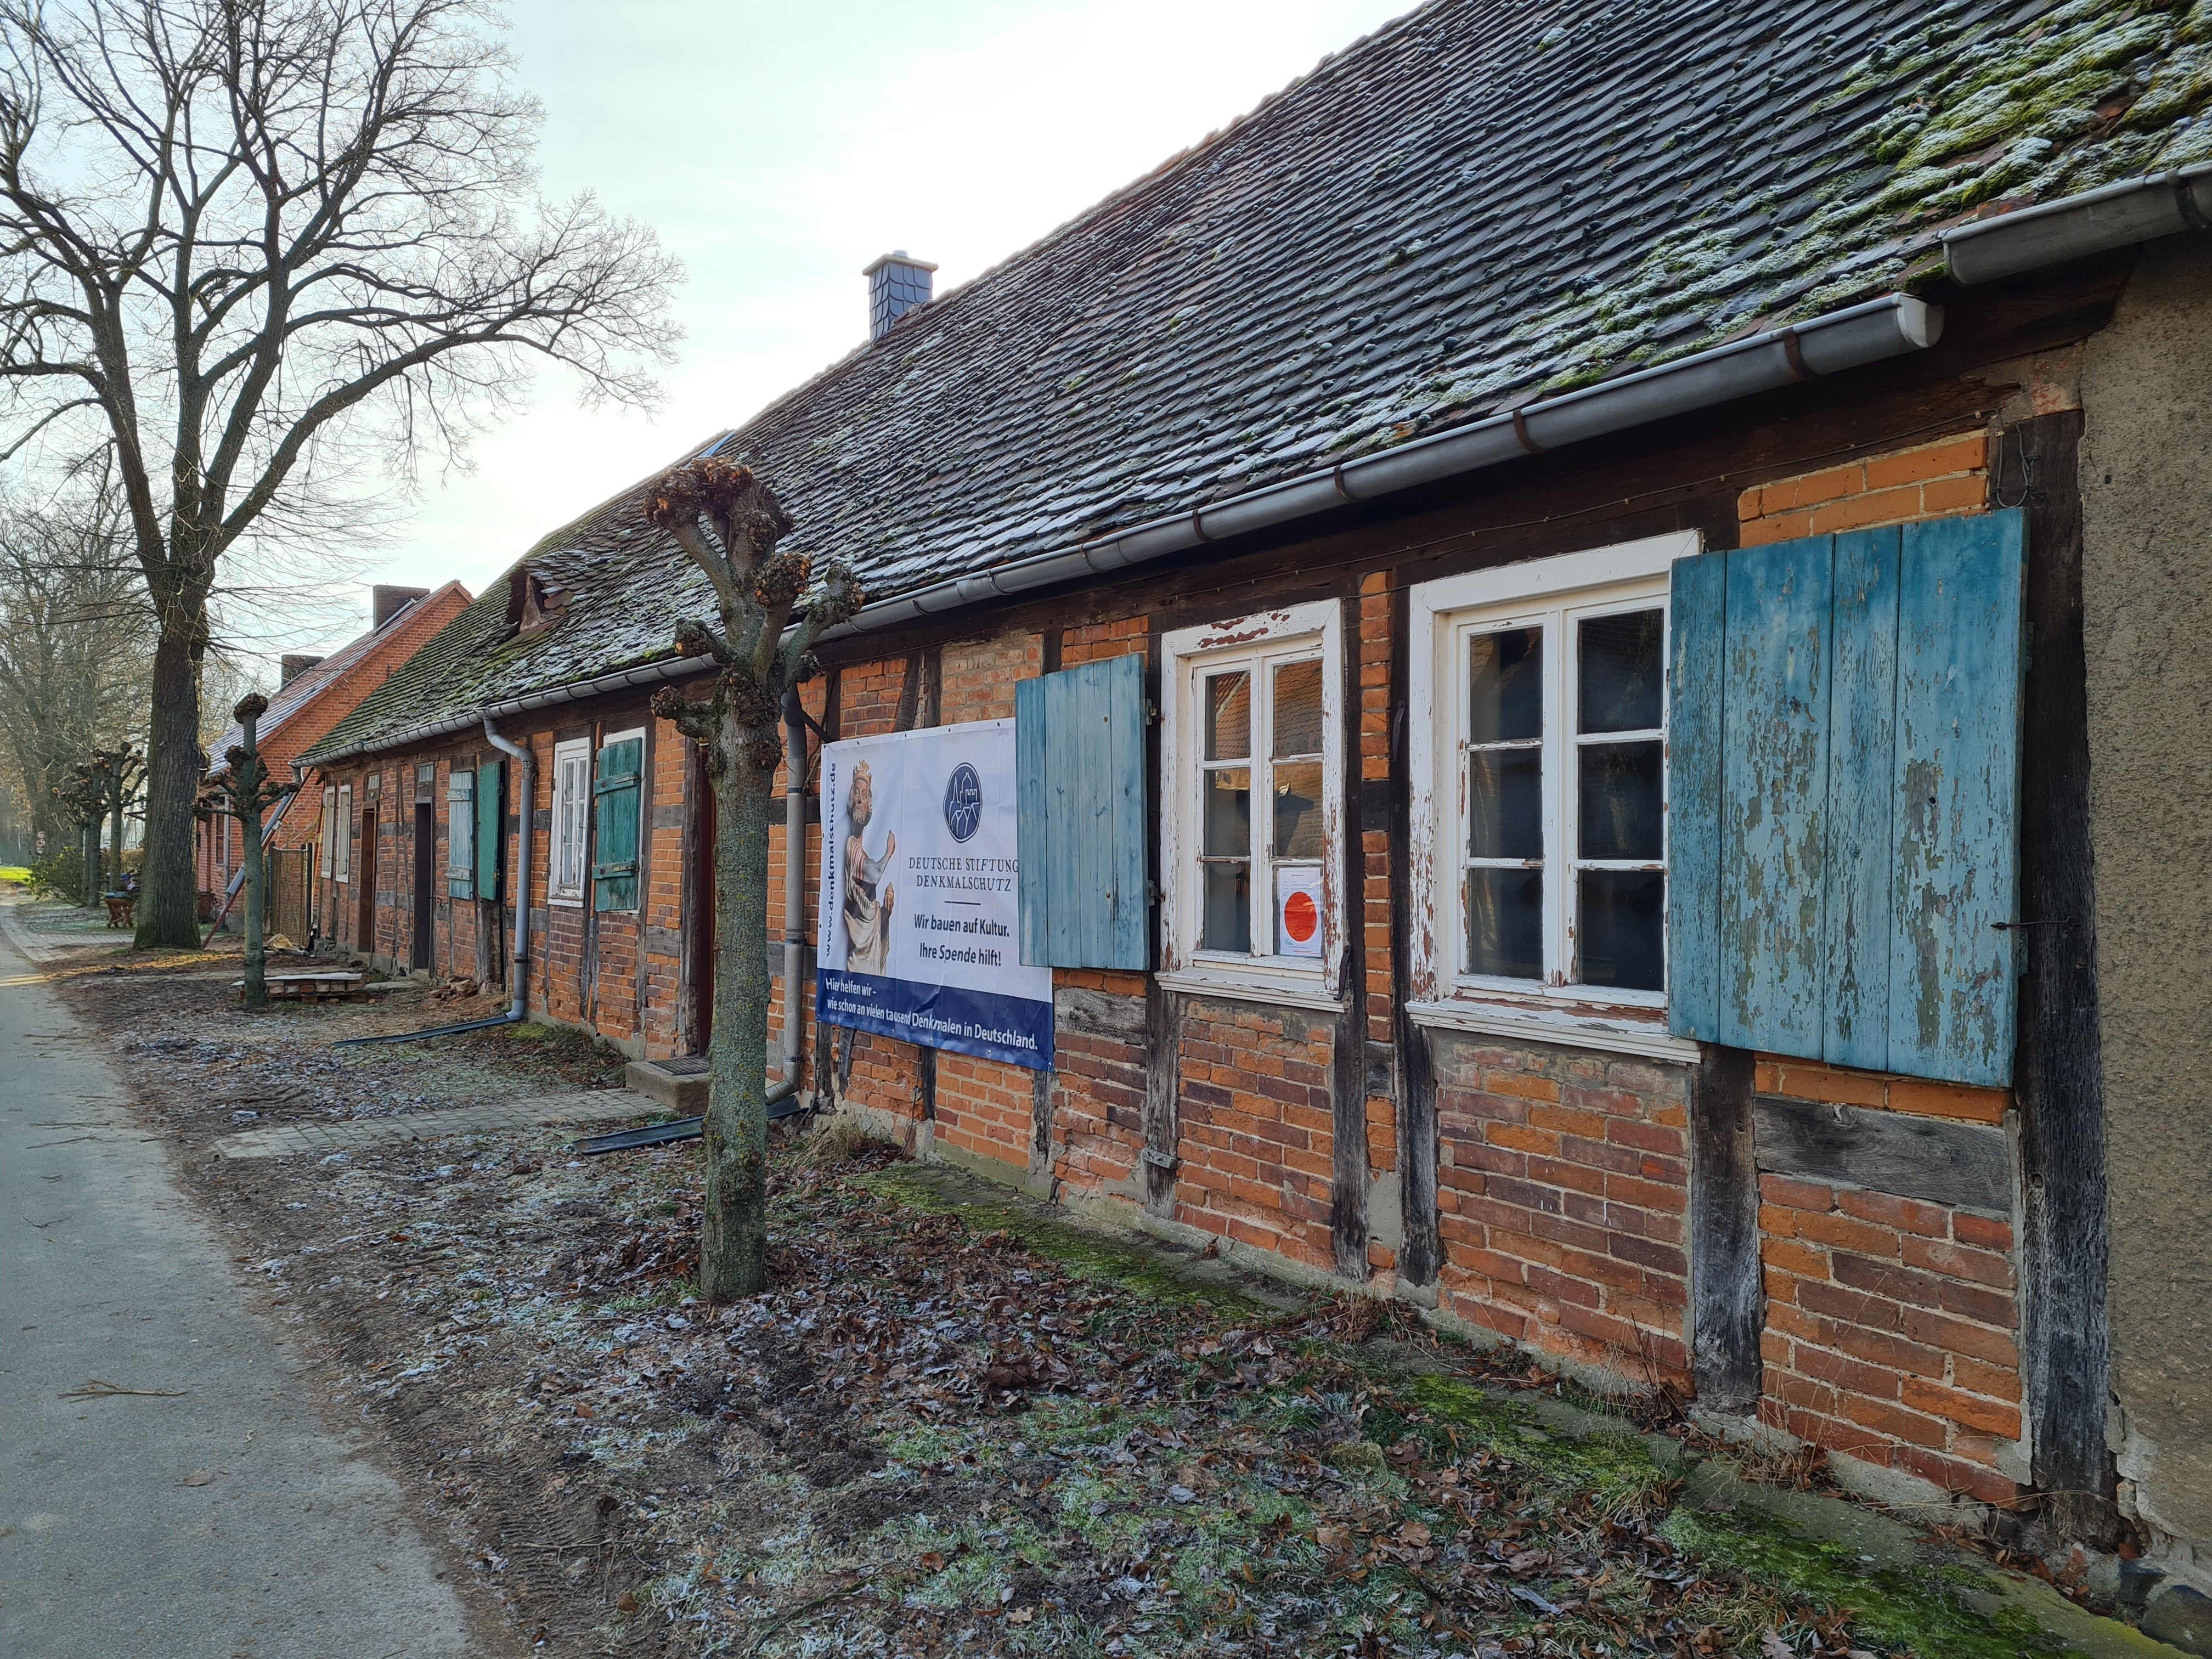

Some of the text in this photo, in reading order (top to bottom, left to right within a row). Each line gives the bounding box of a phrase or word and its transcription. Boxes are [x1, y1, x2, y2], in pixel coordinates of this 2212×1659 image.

[826, 762, 836, 957] www.denkmalschutz.de
[909, 857, 1019, 873] DEUTSCHE STIFTUNG
[916, 875, 1012, 891] DENKMALSCHUTZ
[914, 913, 1010, 938] Wir bauen auf Kultur.
[919, 942, 1001, 967] Ihre Spende hilft!
[825, 978, 840, 991] Hier
[840, 979, 861, 995] helfen
[861, 983, 872, 997] wir
[827, 996, 1038, 1051] wie schon an vielen tausend Denkmalen in Deutschland.
